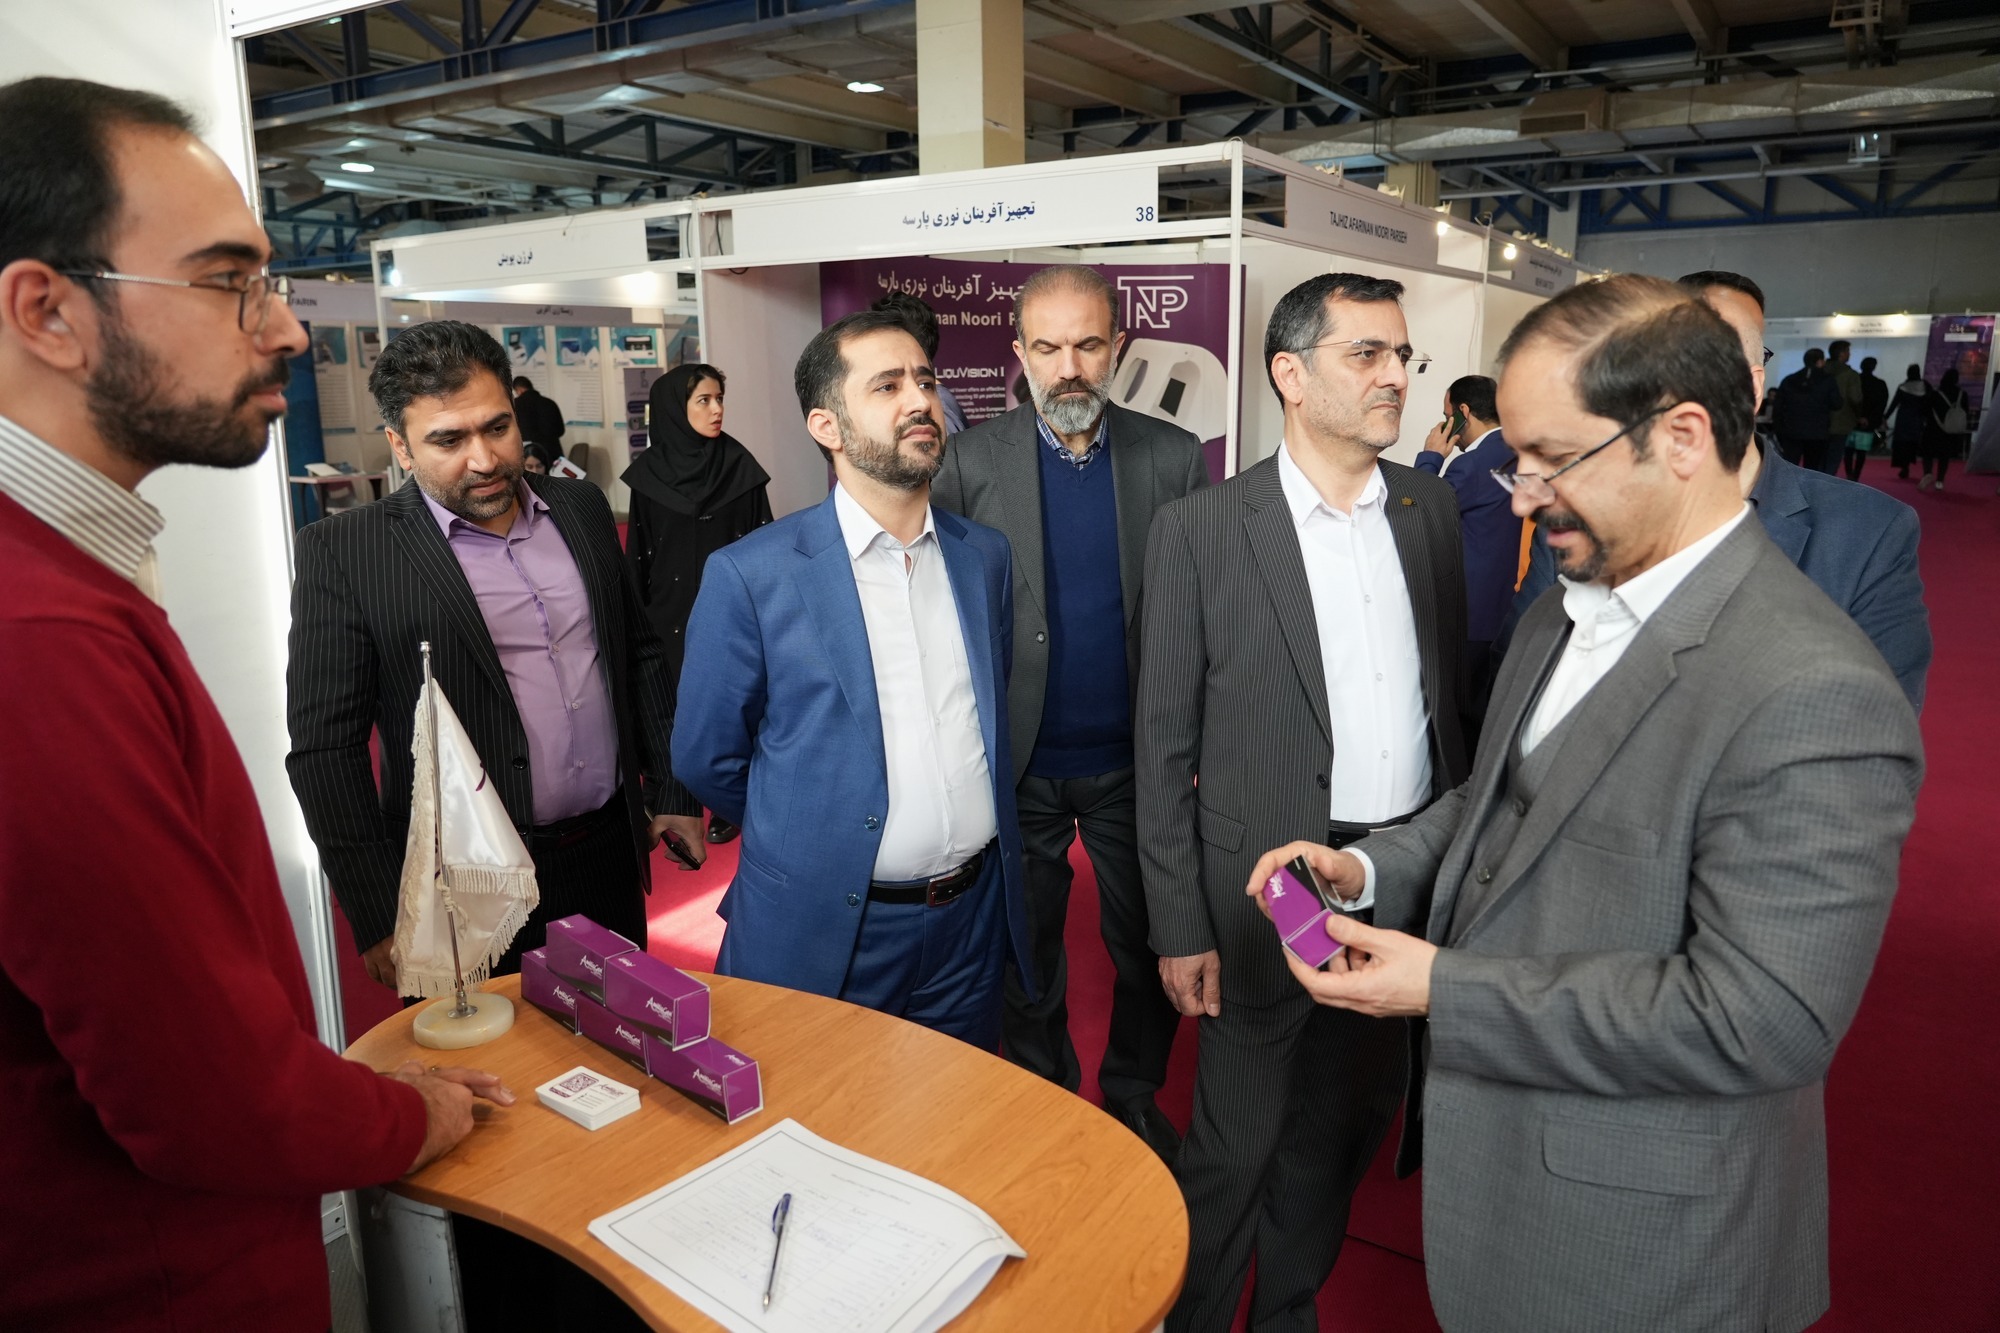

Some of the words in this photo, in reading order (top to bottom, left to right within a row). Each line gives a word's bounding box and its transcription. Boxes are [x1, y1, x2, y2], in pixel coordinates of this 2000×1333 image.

[902, 210, 930, 230] پارسه
[932, 207, 960, 227] نوری
[962, 202, 1004, 225] آفرینان
[1005, 201, 1035, 222] تجهیز
[1136, 206, 1154, 222] 38
[1330, 211, 1348, 229] TAJHIZ
[901, 277, 928, 298] نوری
[932, 274, 982, 302] آفرینان
[960, 312, 1002, 326] Noori
